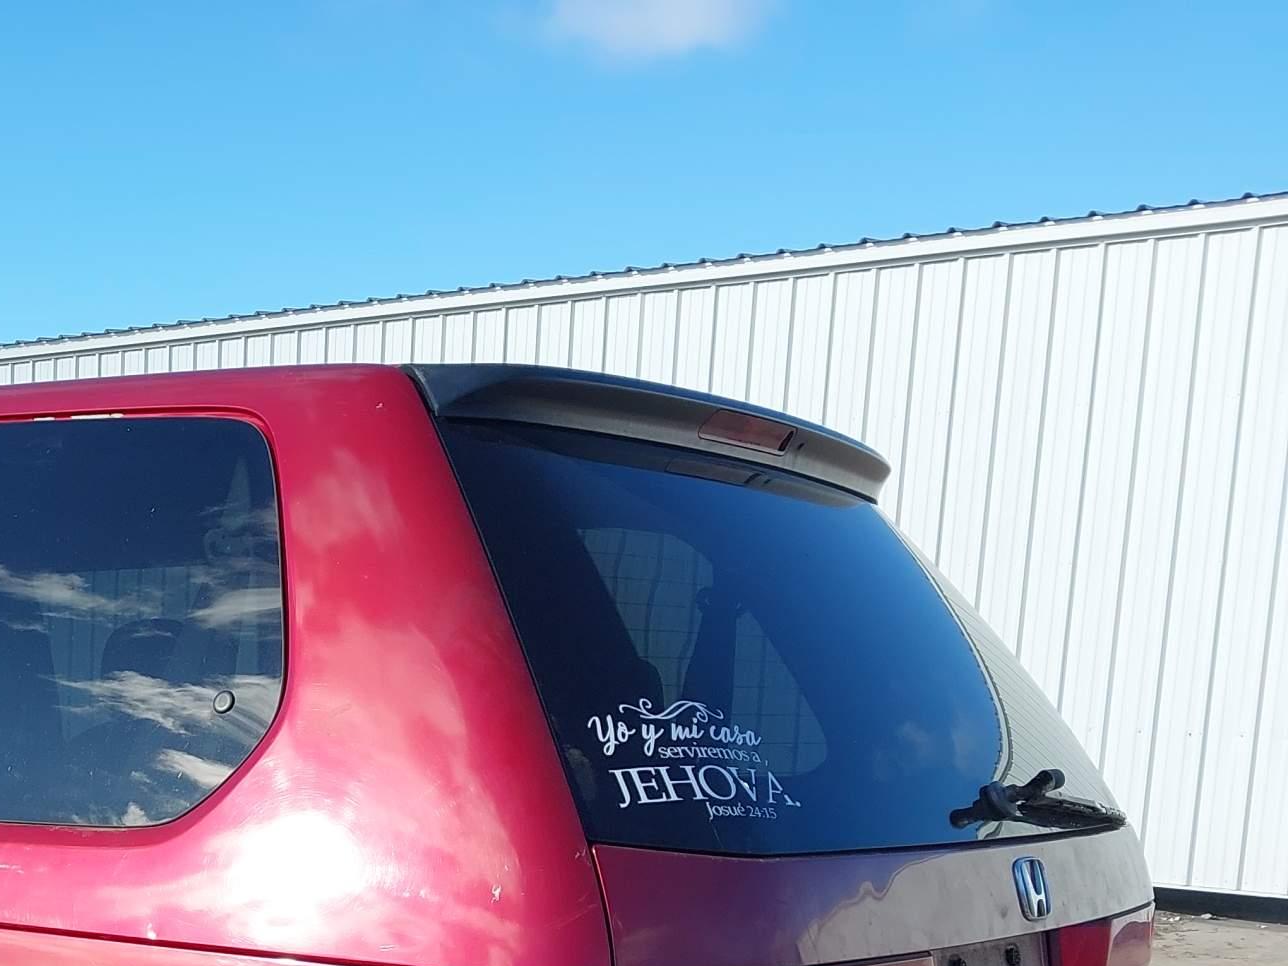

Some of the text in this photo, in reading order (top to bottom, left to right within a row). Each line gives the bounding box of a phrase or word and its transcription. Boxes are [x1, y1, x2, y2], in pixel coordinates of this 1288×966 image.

[587, 714, 762, 756] Yo y mi casa
[658, 742, 761, 763] serviremos a
[746, 805, 777, 819] 24:15
